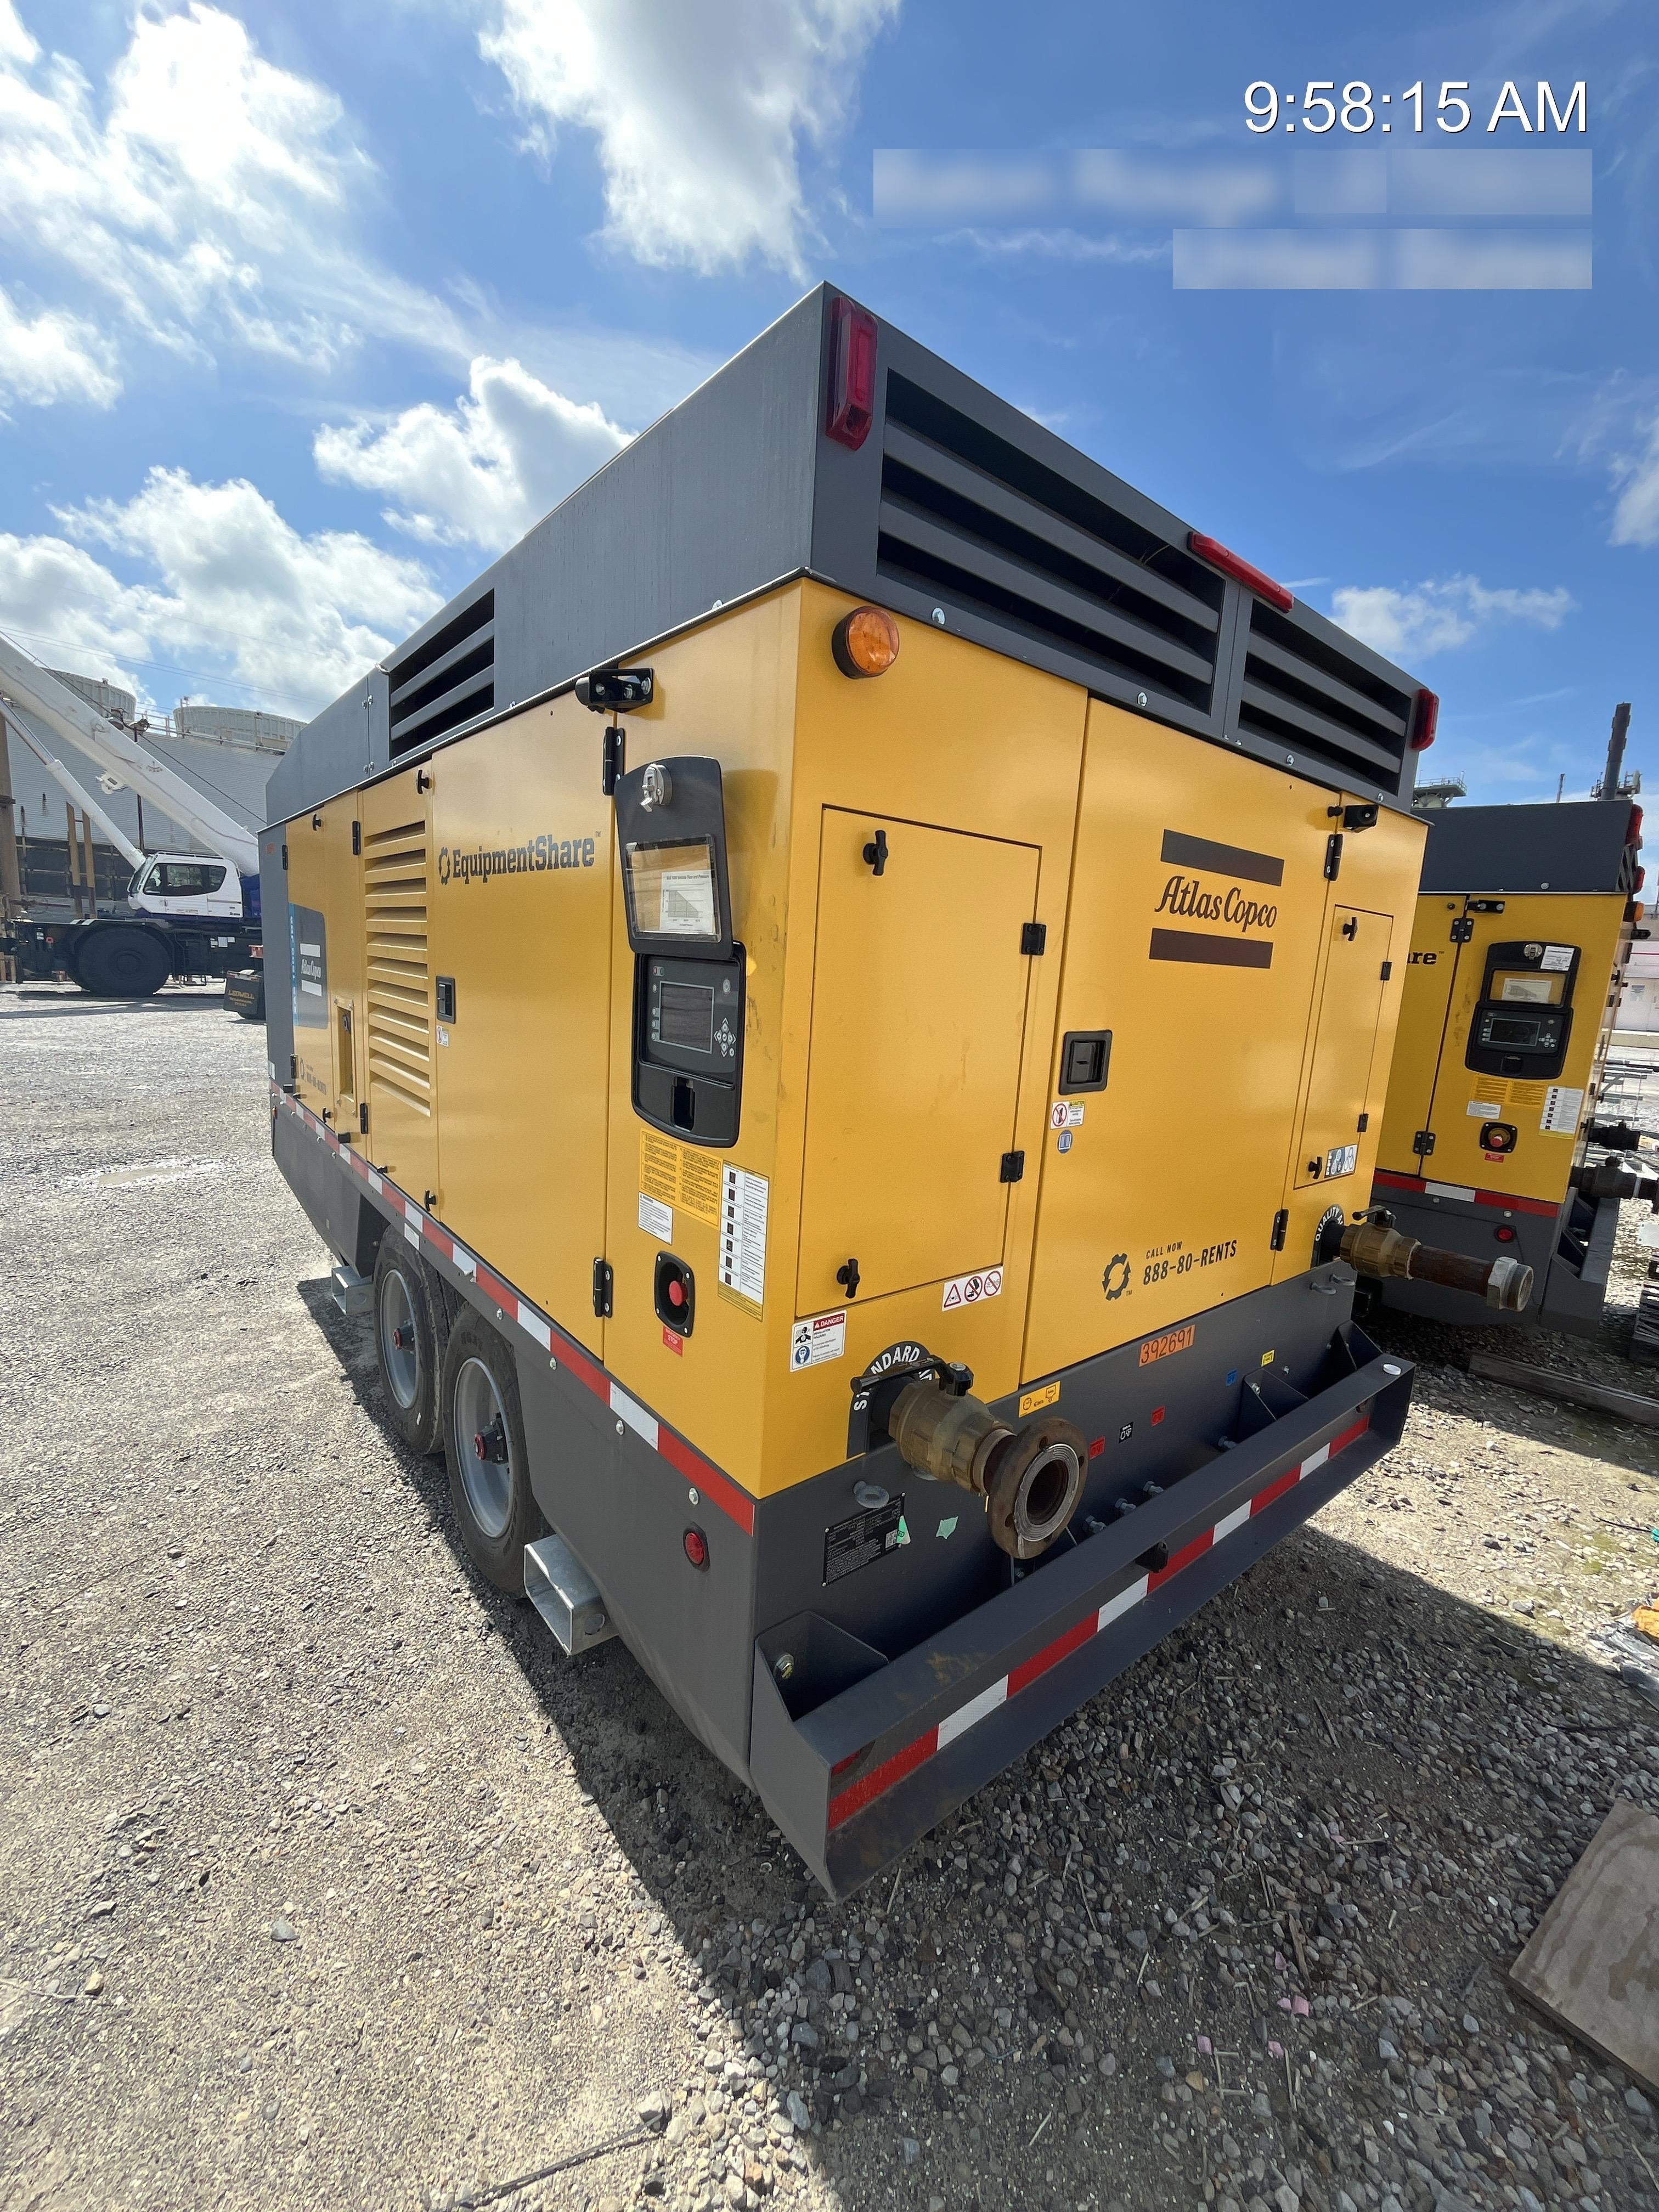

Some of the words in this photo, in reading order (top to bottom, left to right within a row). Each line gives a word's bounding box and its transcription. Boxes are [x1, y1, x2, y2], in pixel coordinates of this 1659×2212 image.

[453, 834, 595, 884] EquipmentShare
[1154, 876, 1223, 921] Atlas
[1224, 887, 1278, 933] Copco
[1315, 1206, 1340, 1242] QUALITY
[1143, 1239, 1238, 1285] 888-80-RENTS
[1146, 1246, 1164, 1260] CALL
[1166, 1241, 1183, 1253] NOW
[820, 1316, 844, 1327] DANGER
[1141, 1327, 1192, 1364] 392691
[853, 1345, 921, 1410] STNDARD
